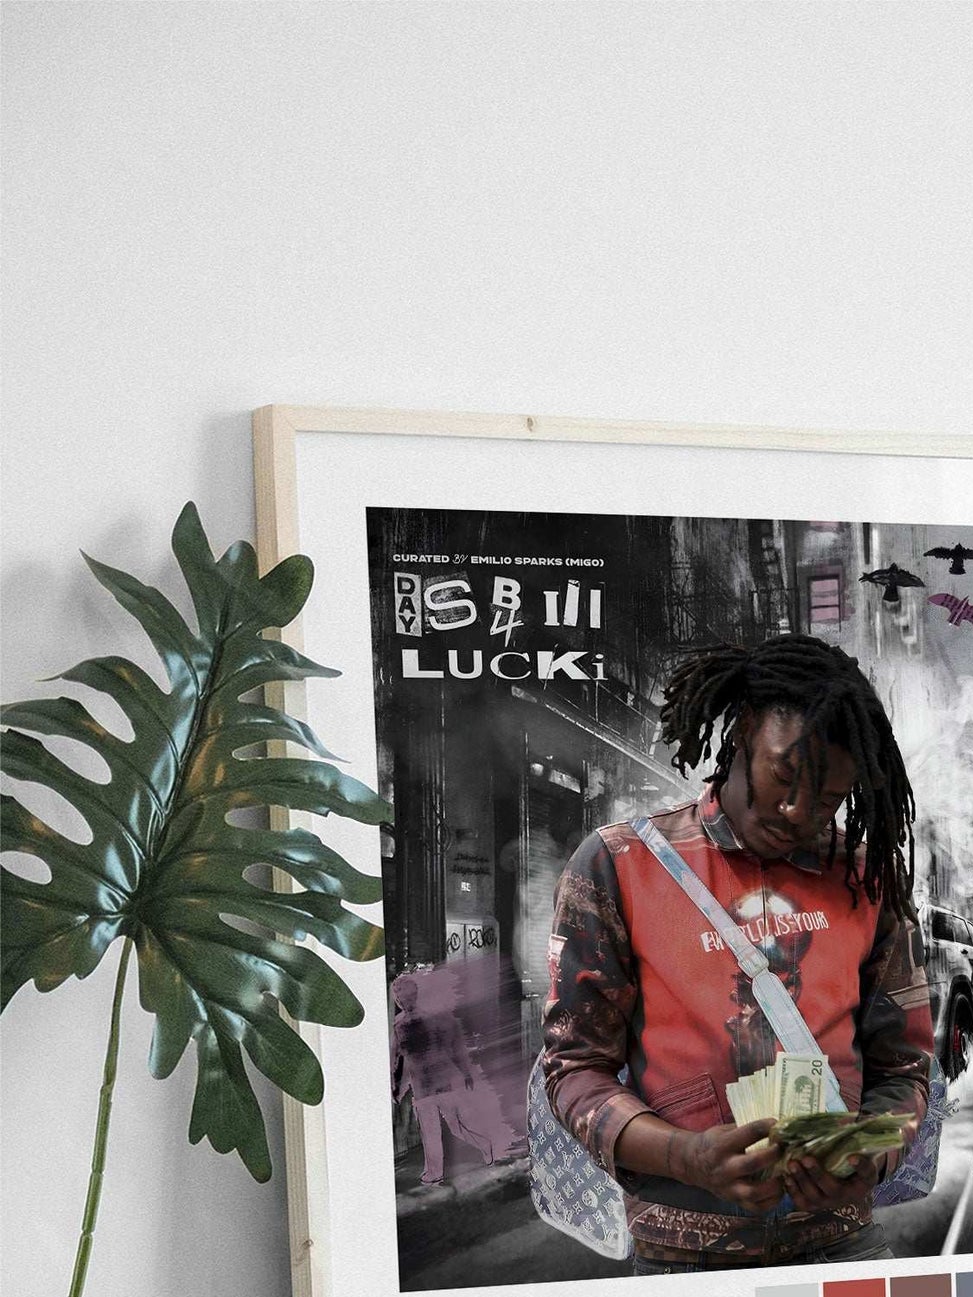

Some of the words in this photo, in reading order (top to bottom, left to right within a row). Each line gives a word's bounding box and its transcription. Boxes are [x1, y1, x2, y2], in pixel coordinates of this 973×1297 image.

[392, 554, 450, 564] CURATED
[470, 555, 512, 565] EMILIO
[514, 556, 563, 566] SPARKS
[811, 1059, 823, 1076] 20
